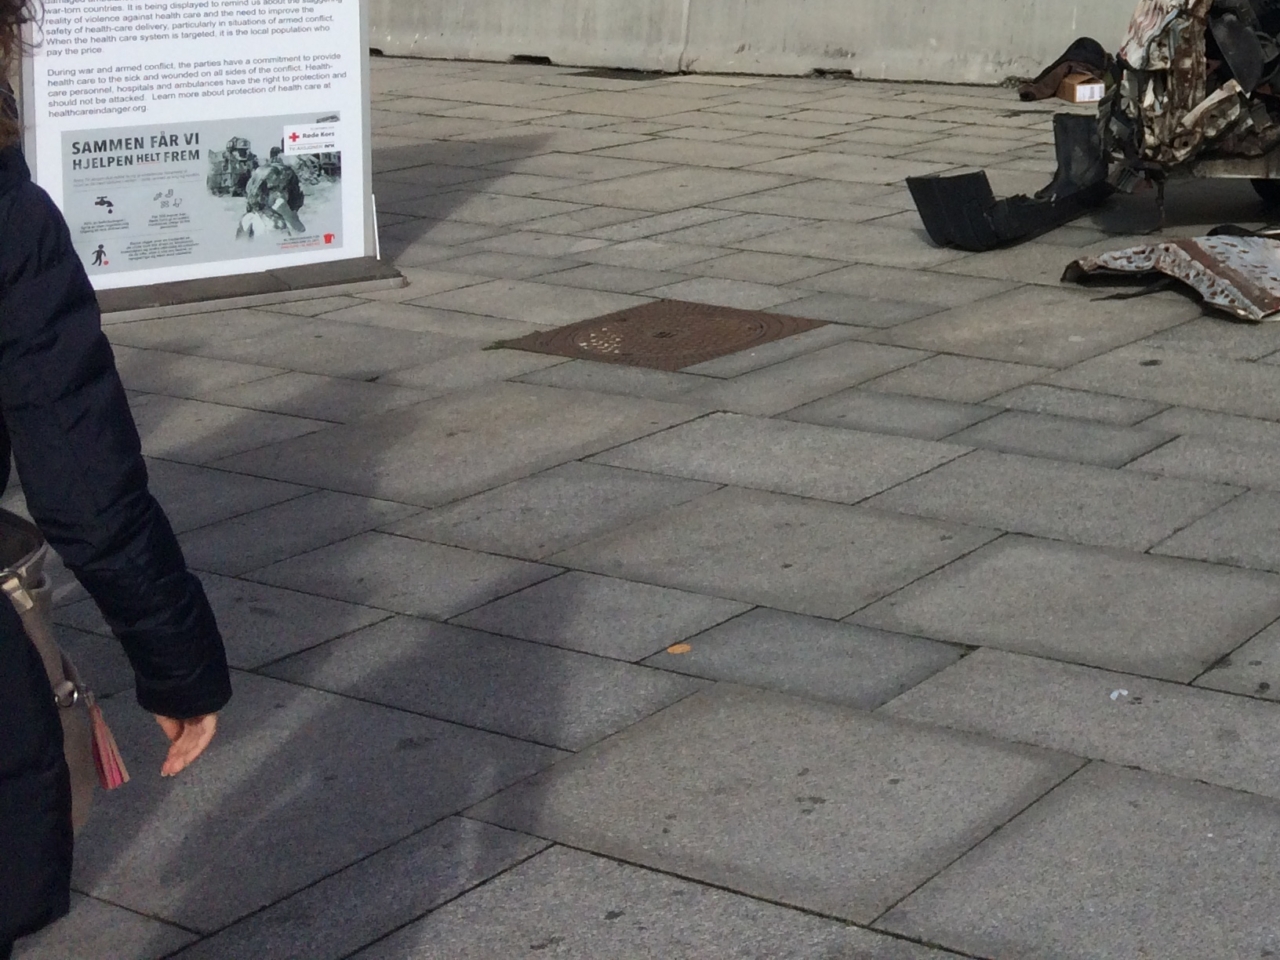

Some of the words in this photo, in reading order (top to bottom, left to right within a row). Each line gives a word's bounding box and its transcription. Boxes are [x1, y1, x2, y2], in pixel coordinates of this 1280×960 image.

[72, 137, 144, 155] SAMMEN
[150, 131, 179, 148] FÅR
[184, 132, 199, 146] VI
[72, 154, 133, 170] HJELPEN
[136, 152, 161, 163] HELT
[164, 149, 200, 162] FREM
